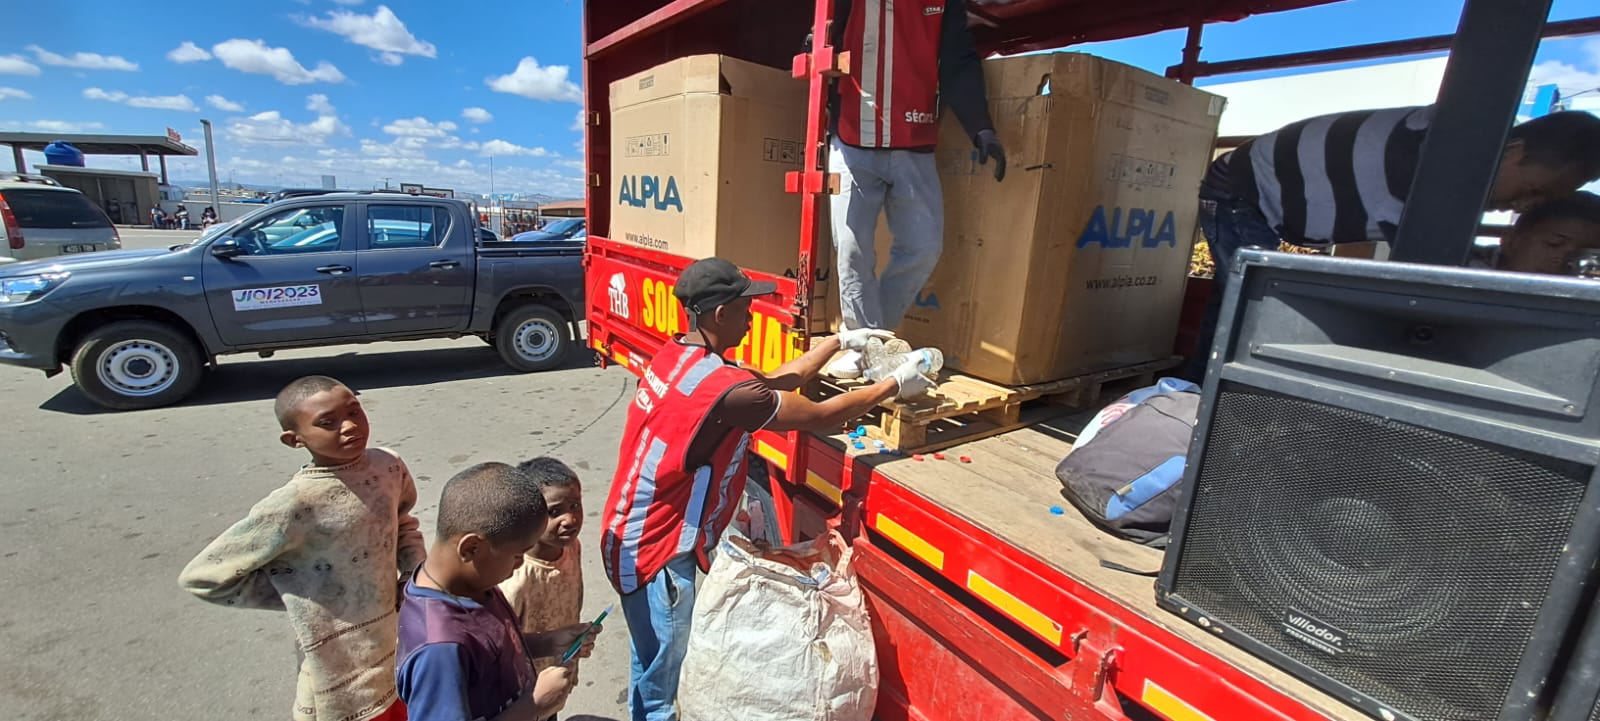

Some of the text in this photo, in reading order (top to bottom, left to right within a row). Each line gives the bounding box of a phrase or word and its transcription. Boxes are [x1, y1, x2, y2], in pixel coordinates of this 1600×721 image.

[619, 174, 683, 213] ALPLA
[1076, 204, 1176, 248] ALPLA
[625, 232, 669, 250] www.alpla.com
[235, 285, 318, 302] JIOI2023
[1086, 275, 1157, 290] www.alpla.co.za
[608, 287, 629, 319] THB
